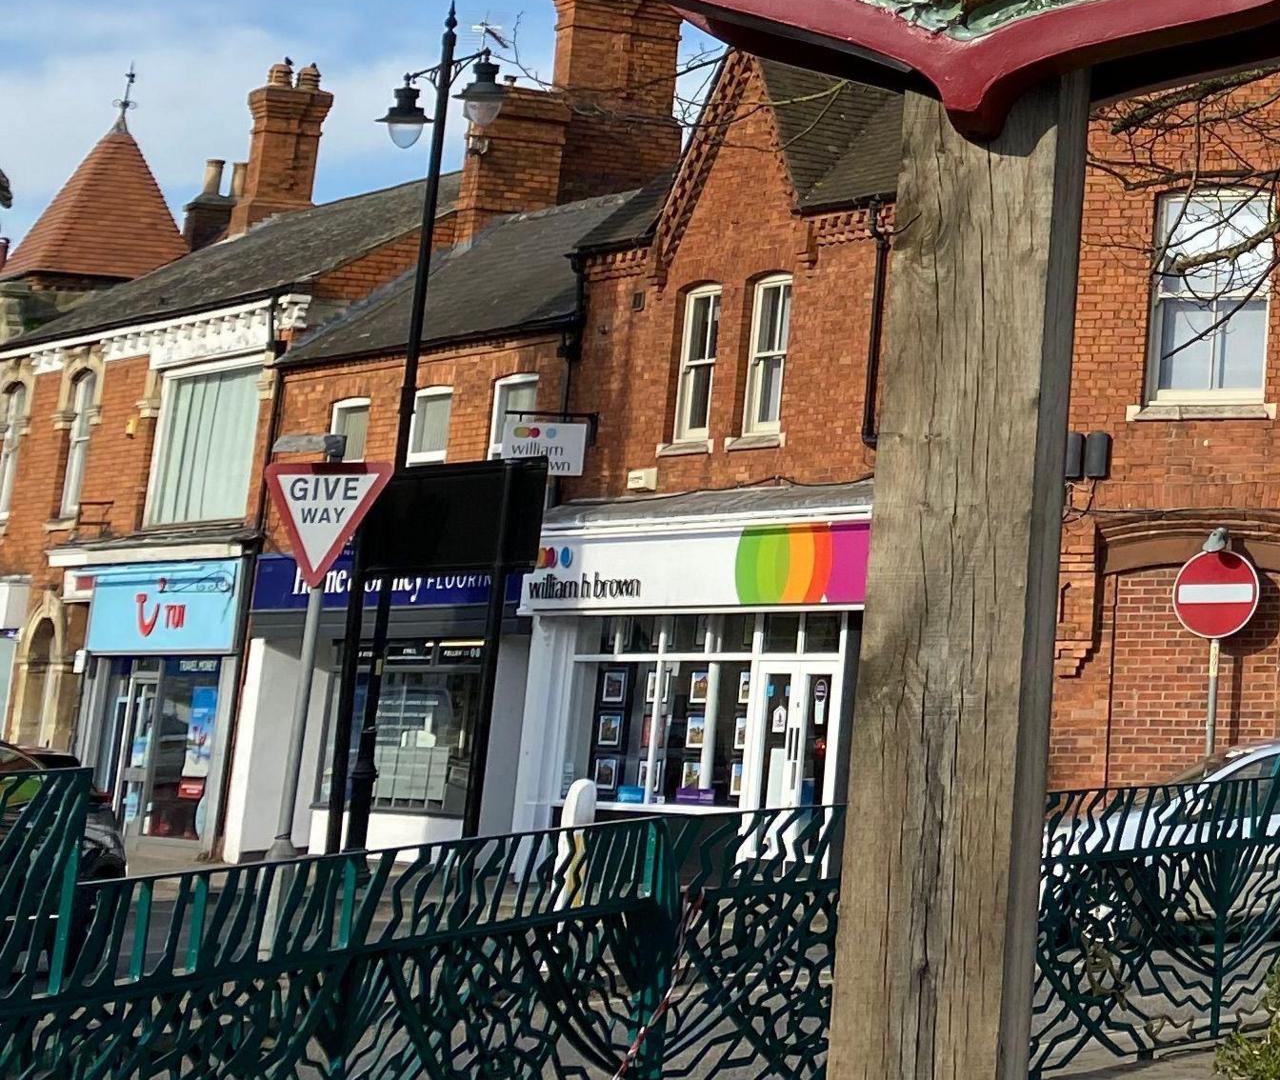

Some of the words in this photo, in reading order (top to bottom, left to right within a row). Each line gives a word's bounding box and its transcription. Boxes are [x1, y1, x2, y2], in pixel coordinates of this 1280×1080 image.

[511, 441, 563, 456] william
[290, 477, 359, 501] GIVE
[301, 507, 345, 523] WAY
[529, 573, 579, 599] william
[580, 573, 591, 598] h
[593, 572, 640, 599] brown
[165, 604, 186, 628] TUI
